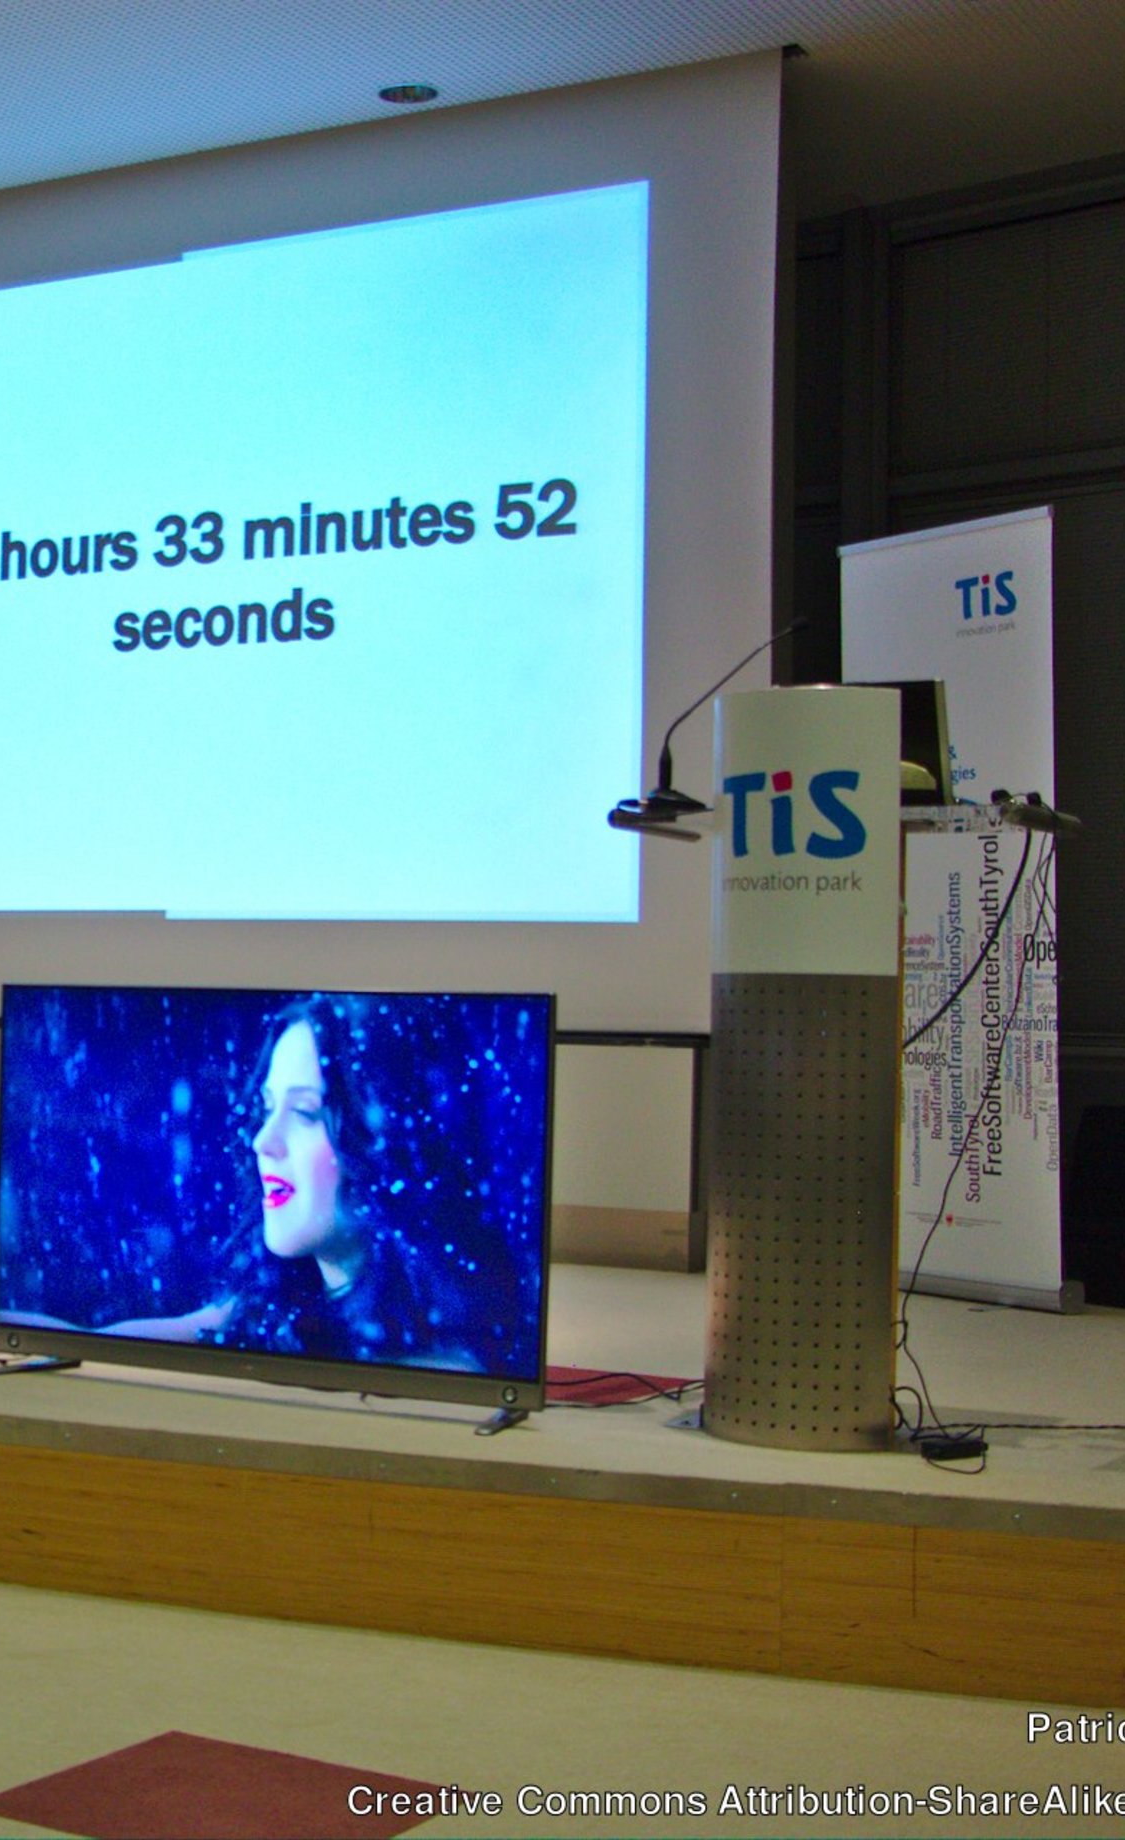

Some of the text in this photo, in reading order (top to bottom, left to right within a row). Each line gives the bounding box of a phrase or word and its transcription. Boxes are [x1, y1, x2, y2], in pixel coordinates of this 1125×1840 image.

[0, 531, 138, 581] hours
[153, 511, 225, 568] 33
[244, 497, 475, 560] minutes
[494, 479, 577, 540] 52
[113, 588, 335, 652] seconds
[816, 868, 863, 895] park
[977, 835, 1003, 1176] FreeSoftwareCenterSouthTyrol
[1033, 1039, 1043, 1063] Wiki
[931, 1066, 942, 1140] RoadTraffic
[965, 1113, 984, 1203] SouthTyrol
